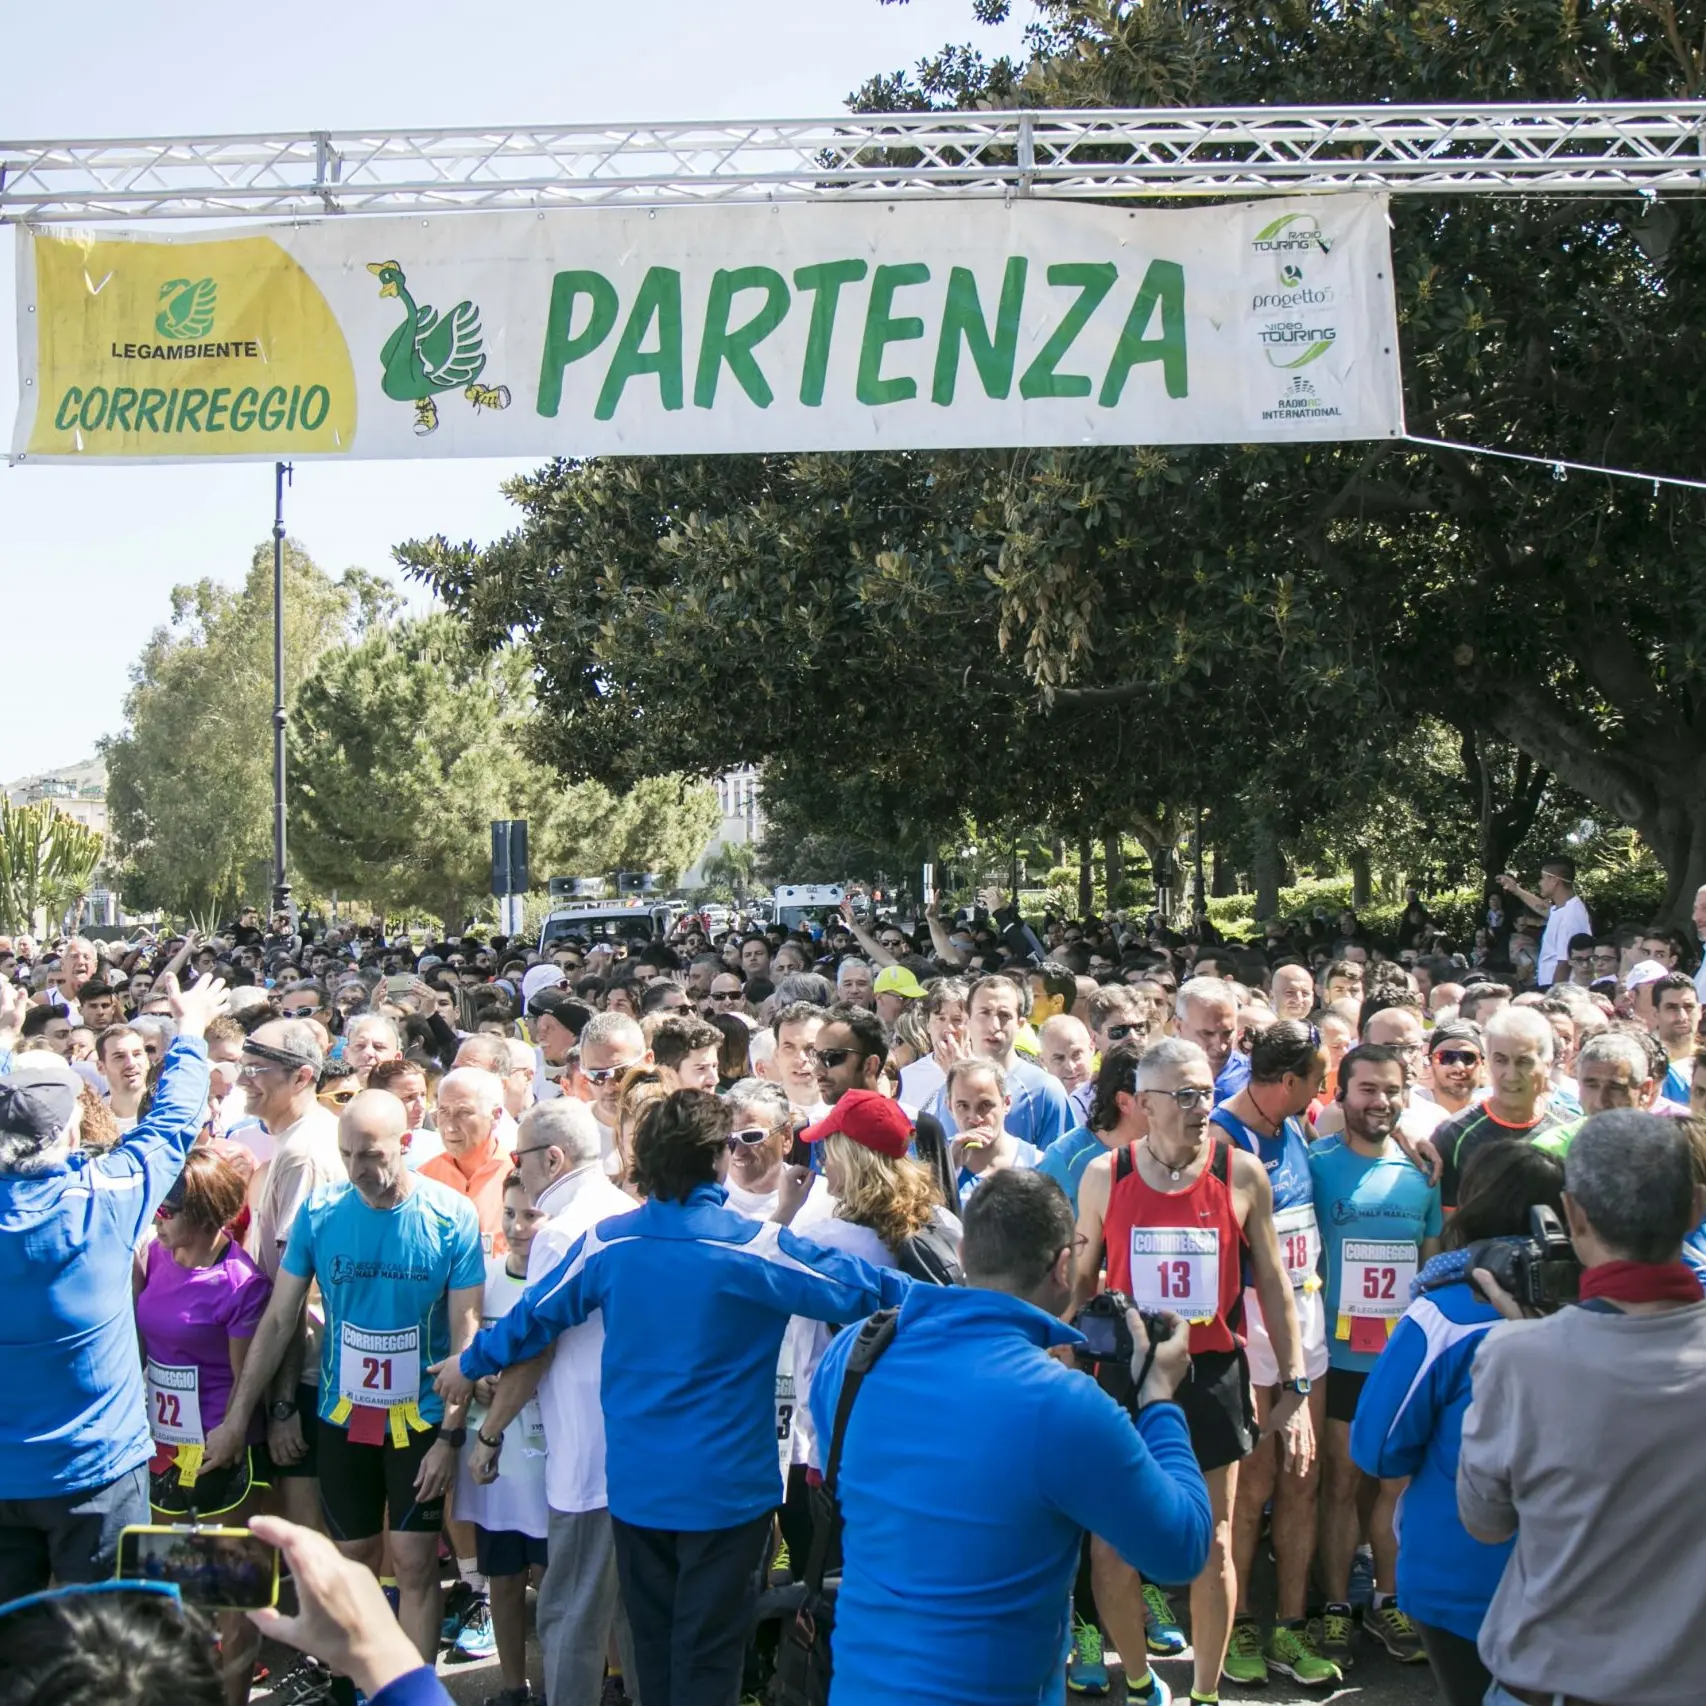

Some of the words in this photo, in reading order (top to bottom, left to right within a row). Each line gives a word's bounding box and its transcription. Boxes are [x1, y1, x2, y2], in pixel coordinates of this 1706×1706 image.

[111, 341, 258, 360] LEGAMBIENTE
[536, 256, 1188, 420] PARTENZA
[54, 384, 331, 433] CORRIREGGIO
[1262, 408, 1341, 419] INTERNATIONAL
[1286, 1235, 1306, 1268] 18
[1346, 1243, 1415, 1261] CORRIREGGIO
[1157, 1261, 1190, 1298] 13
[1363, 1267, 1396, 1299] 52
[344, 1327, 416, 1352] CORRIREGGIO
[363, 1357, 392, 1390] 21
[156, 1391, 183, 1427] 22
[354, 1395, 414, 1406] LEGAMBIENTE
